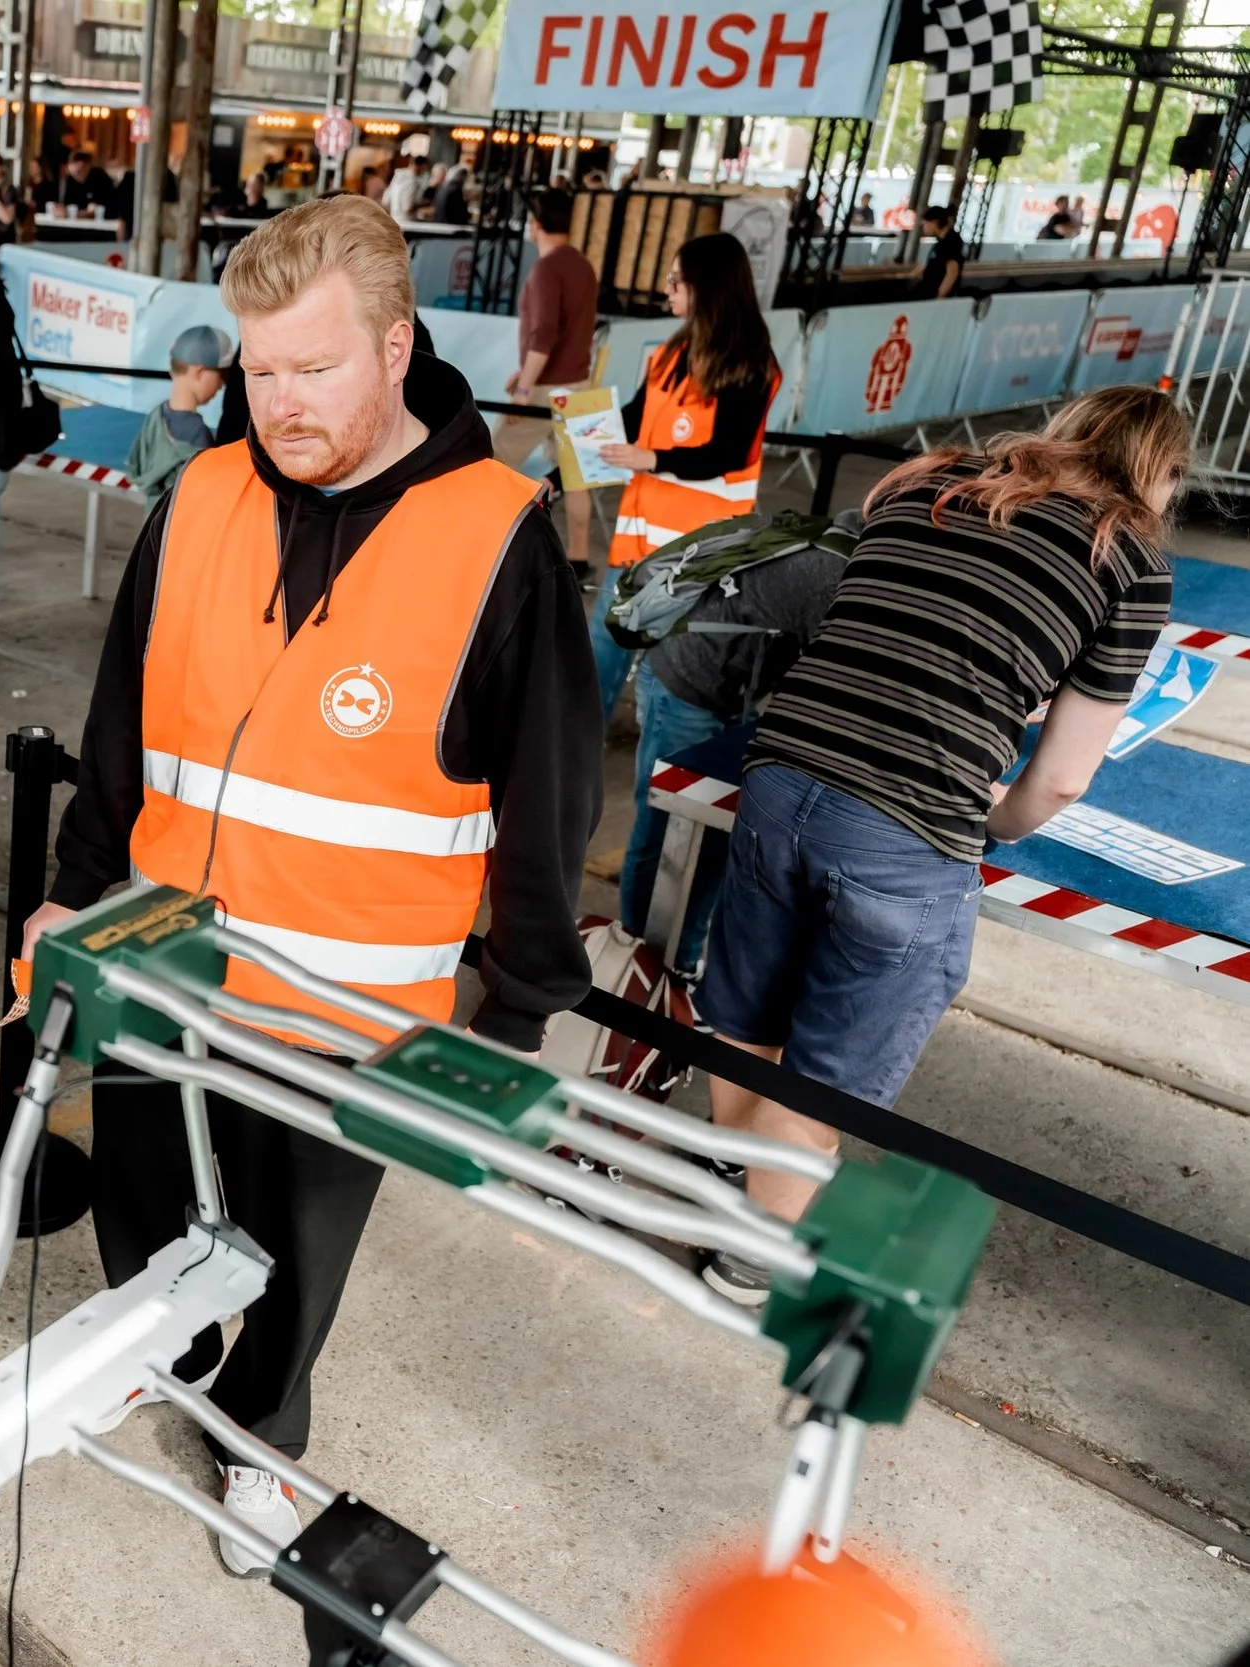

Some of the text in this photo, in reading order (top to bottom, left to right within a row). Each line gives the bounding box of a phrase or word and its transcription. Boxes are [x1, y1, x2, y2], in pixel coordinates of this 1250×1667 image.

[95, 27, 147, 56] DRIN
[534, 11, 828, 89] FINISH
[32, 280, 128, 334] Maker Faire
[32, 315, 74, 359] Gent
[325, 708, 377, 734] TECHNOPILOOT
